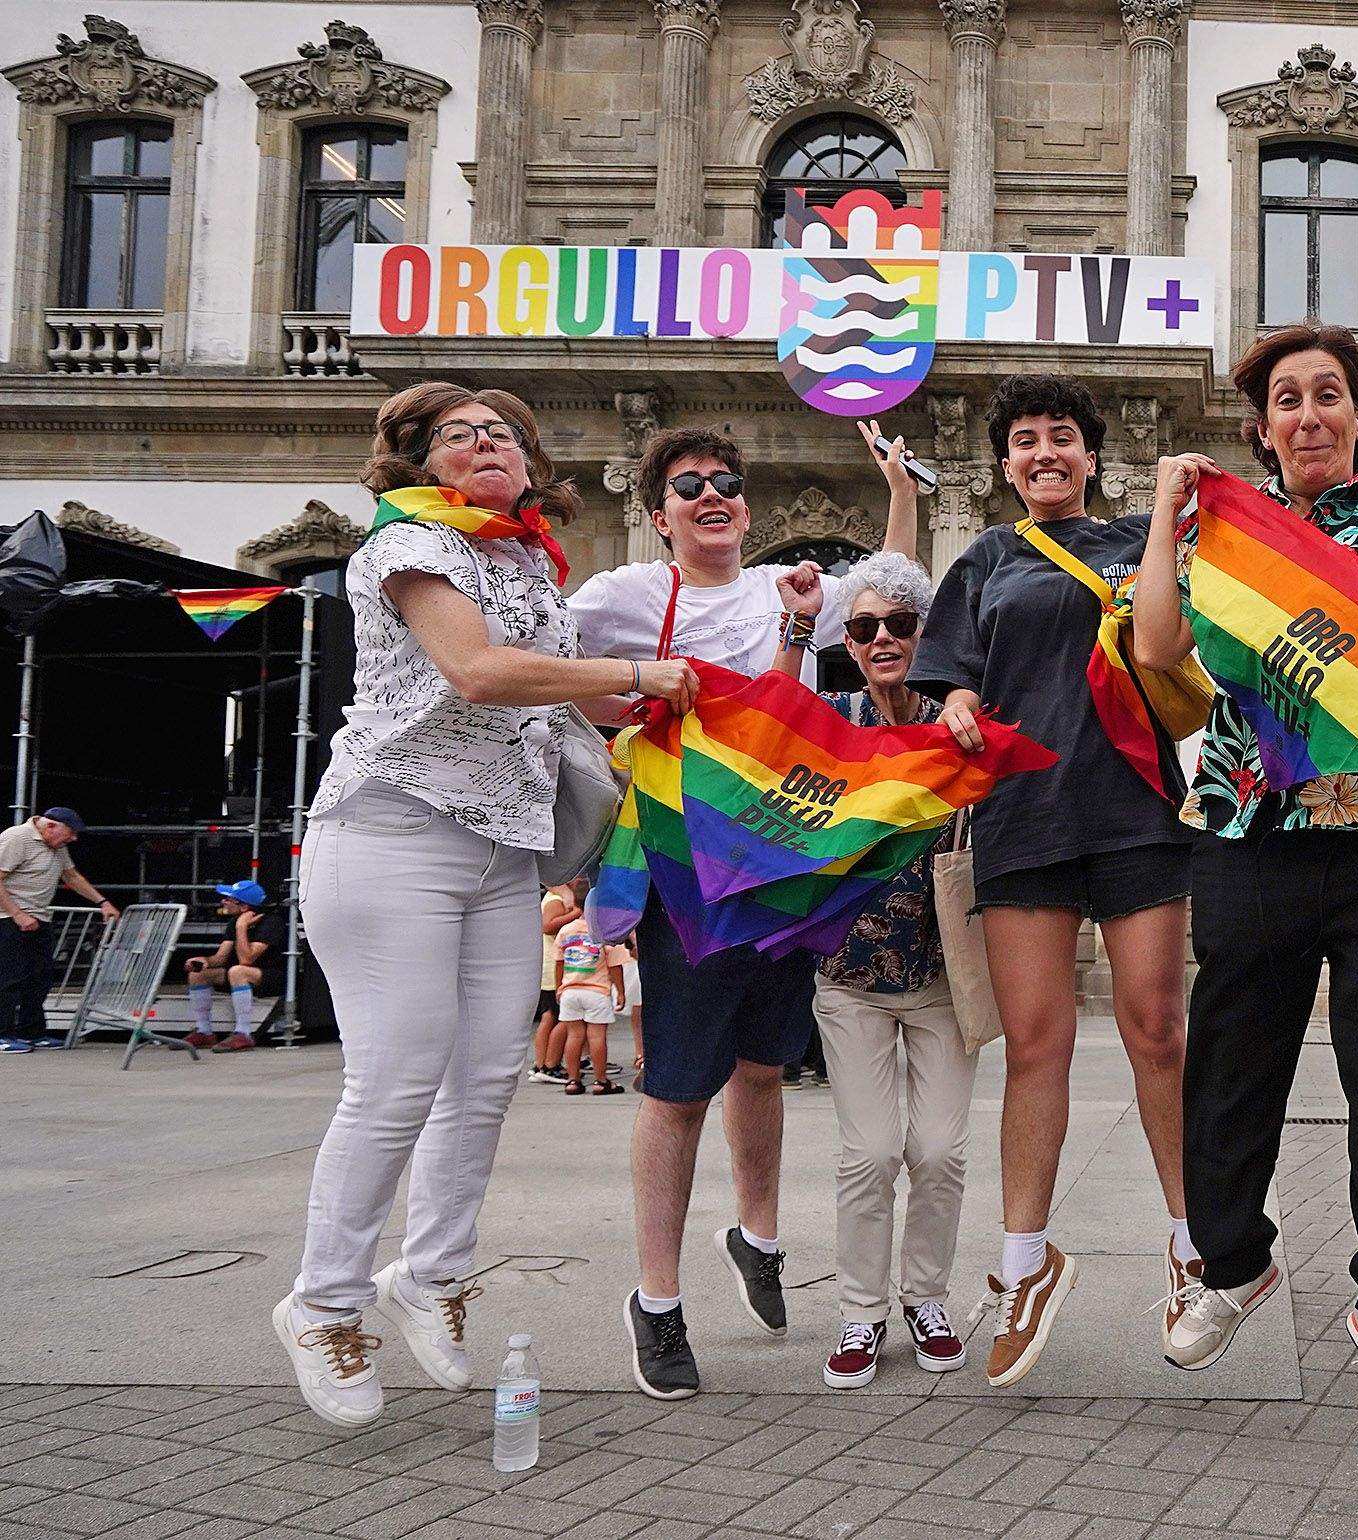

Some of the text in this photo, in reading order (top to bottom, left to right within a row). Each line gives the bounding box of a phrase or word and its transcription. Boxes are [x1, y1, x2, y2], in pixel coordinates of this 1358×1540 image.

[380, 244, 752, 338] ORGULLO
[1287, 607, 1356, 666] ORG
[1262, 635, 1324, 707] ULLO
[760, 788, 833, 832] ULLO
[781, 764, 848, 806] ORG
